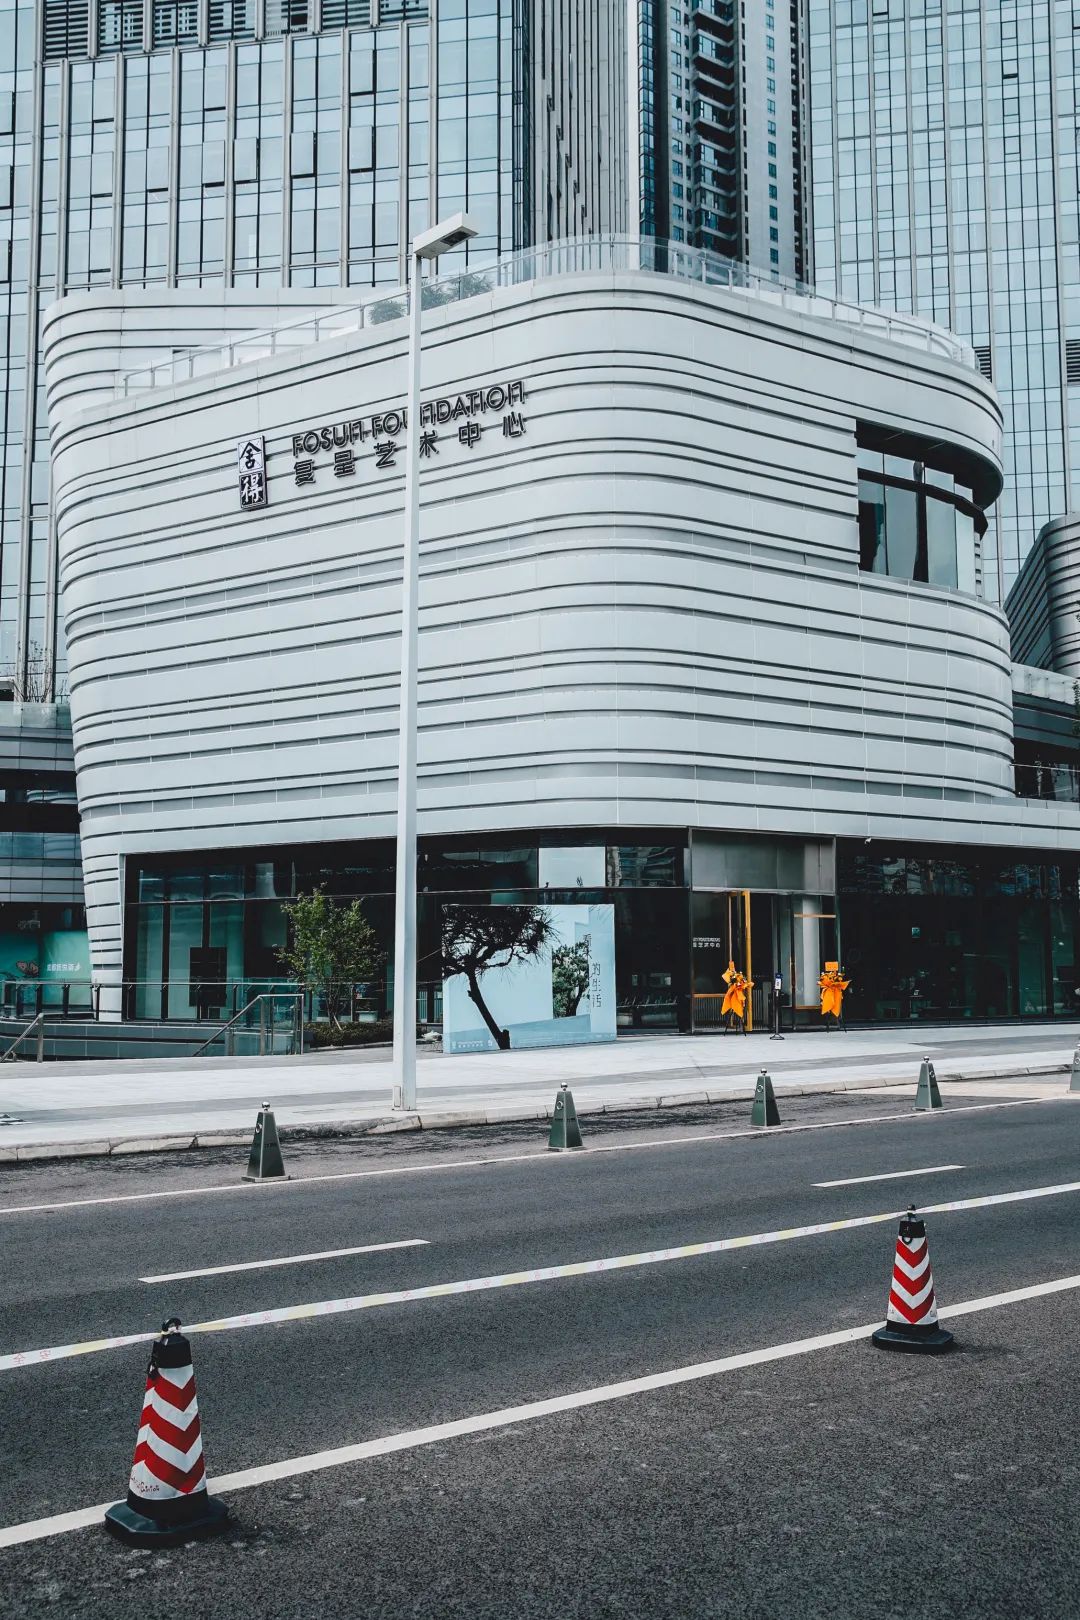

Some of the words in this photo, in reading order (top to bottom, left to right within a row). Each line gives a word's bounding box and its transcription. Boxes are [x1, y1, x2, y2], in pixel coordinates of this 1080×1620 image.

[292, 421, 365, 458] FOSUN
[294, 411, 527, 487] 复星艺术中心
[238, 441, 264, 504] 舍得
